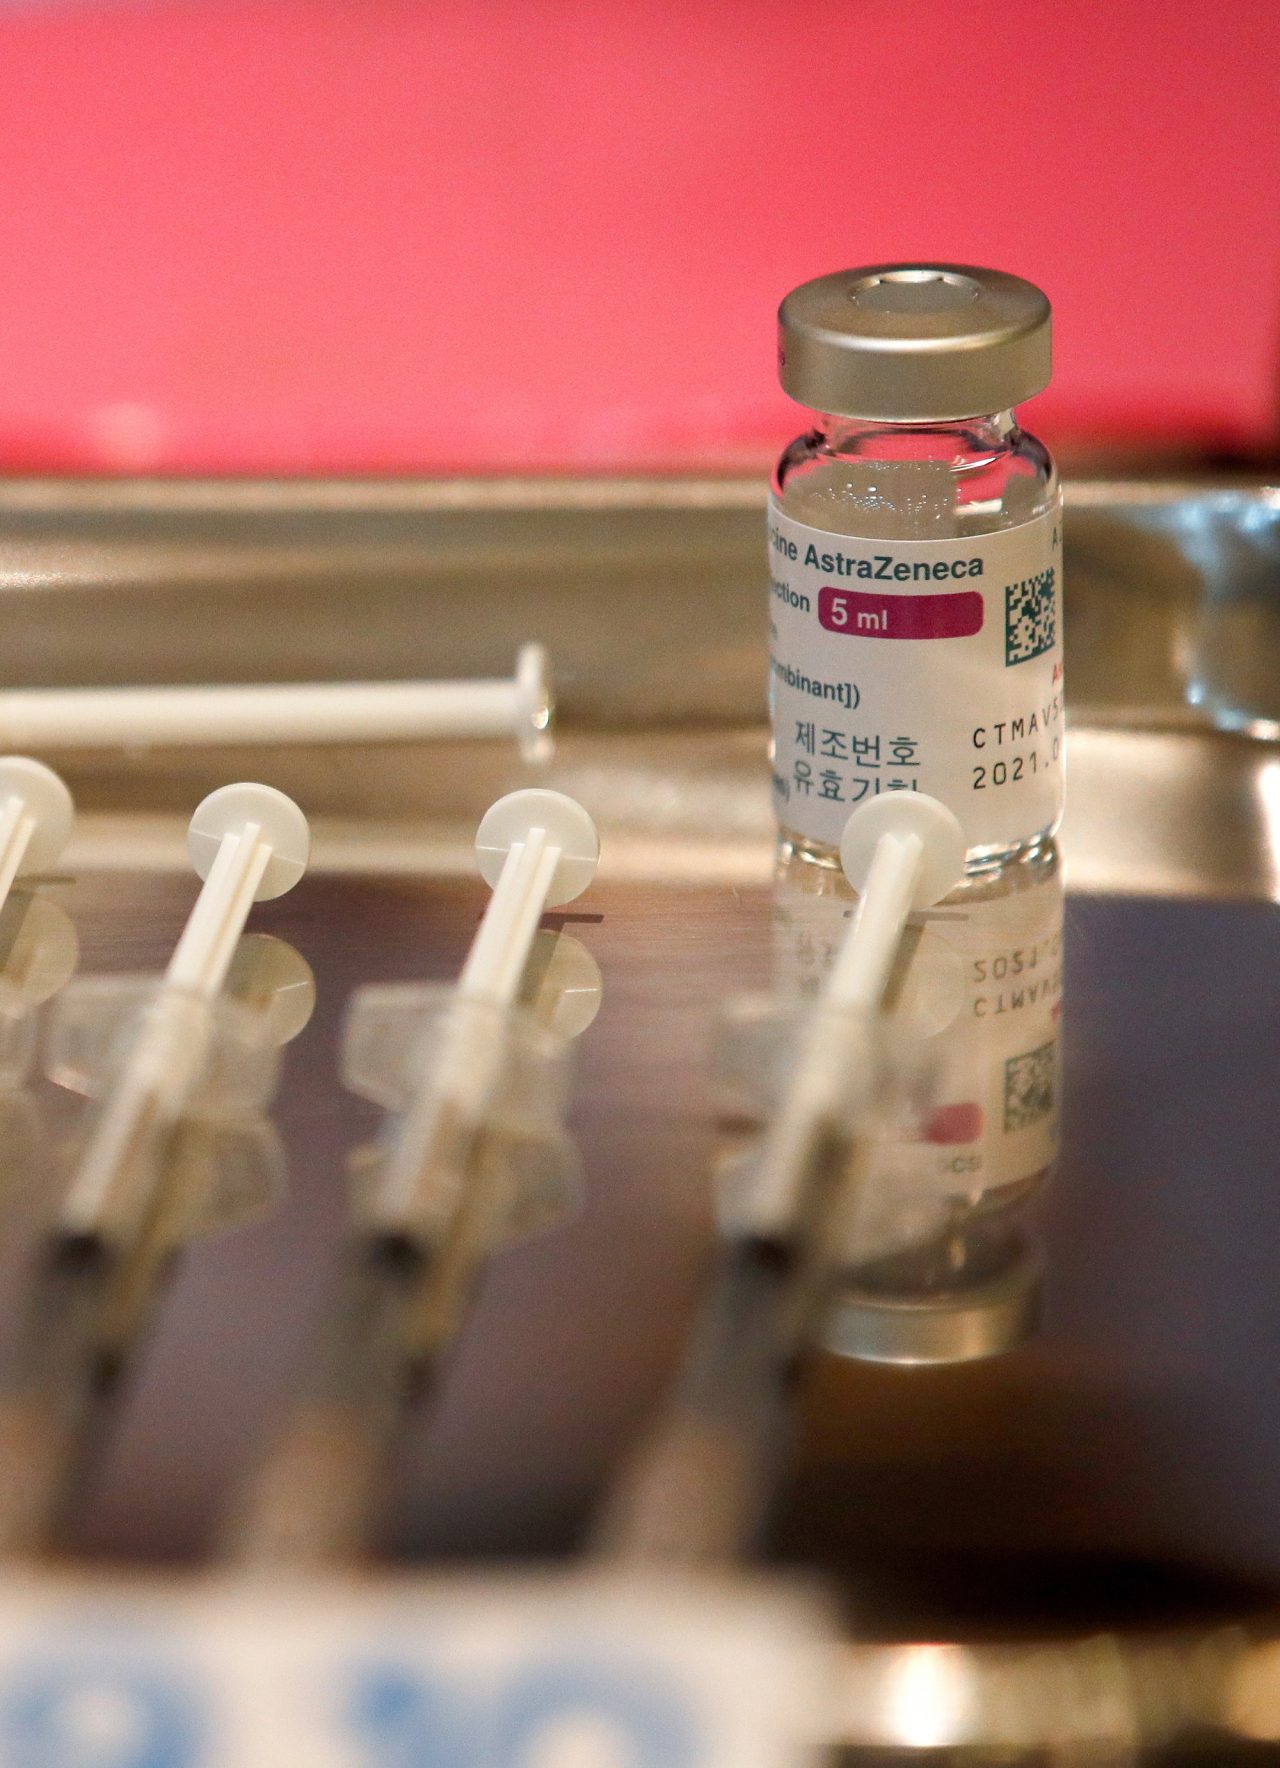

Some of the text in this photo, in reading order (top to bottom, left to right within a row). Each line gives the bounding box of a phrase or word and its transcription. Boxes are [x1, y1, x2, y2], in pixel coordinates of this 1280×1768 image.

[804, 543, 984, 581] AstraZeneca
[773, 581, 888, 631] ction 5 ml
[795, 720, 921, 768] 제조번호
